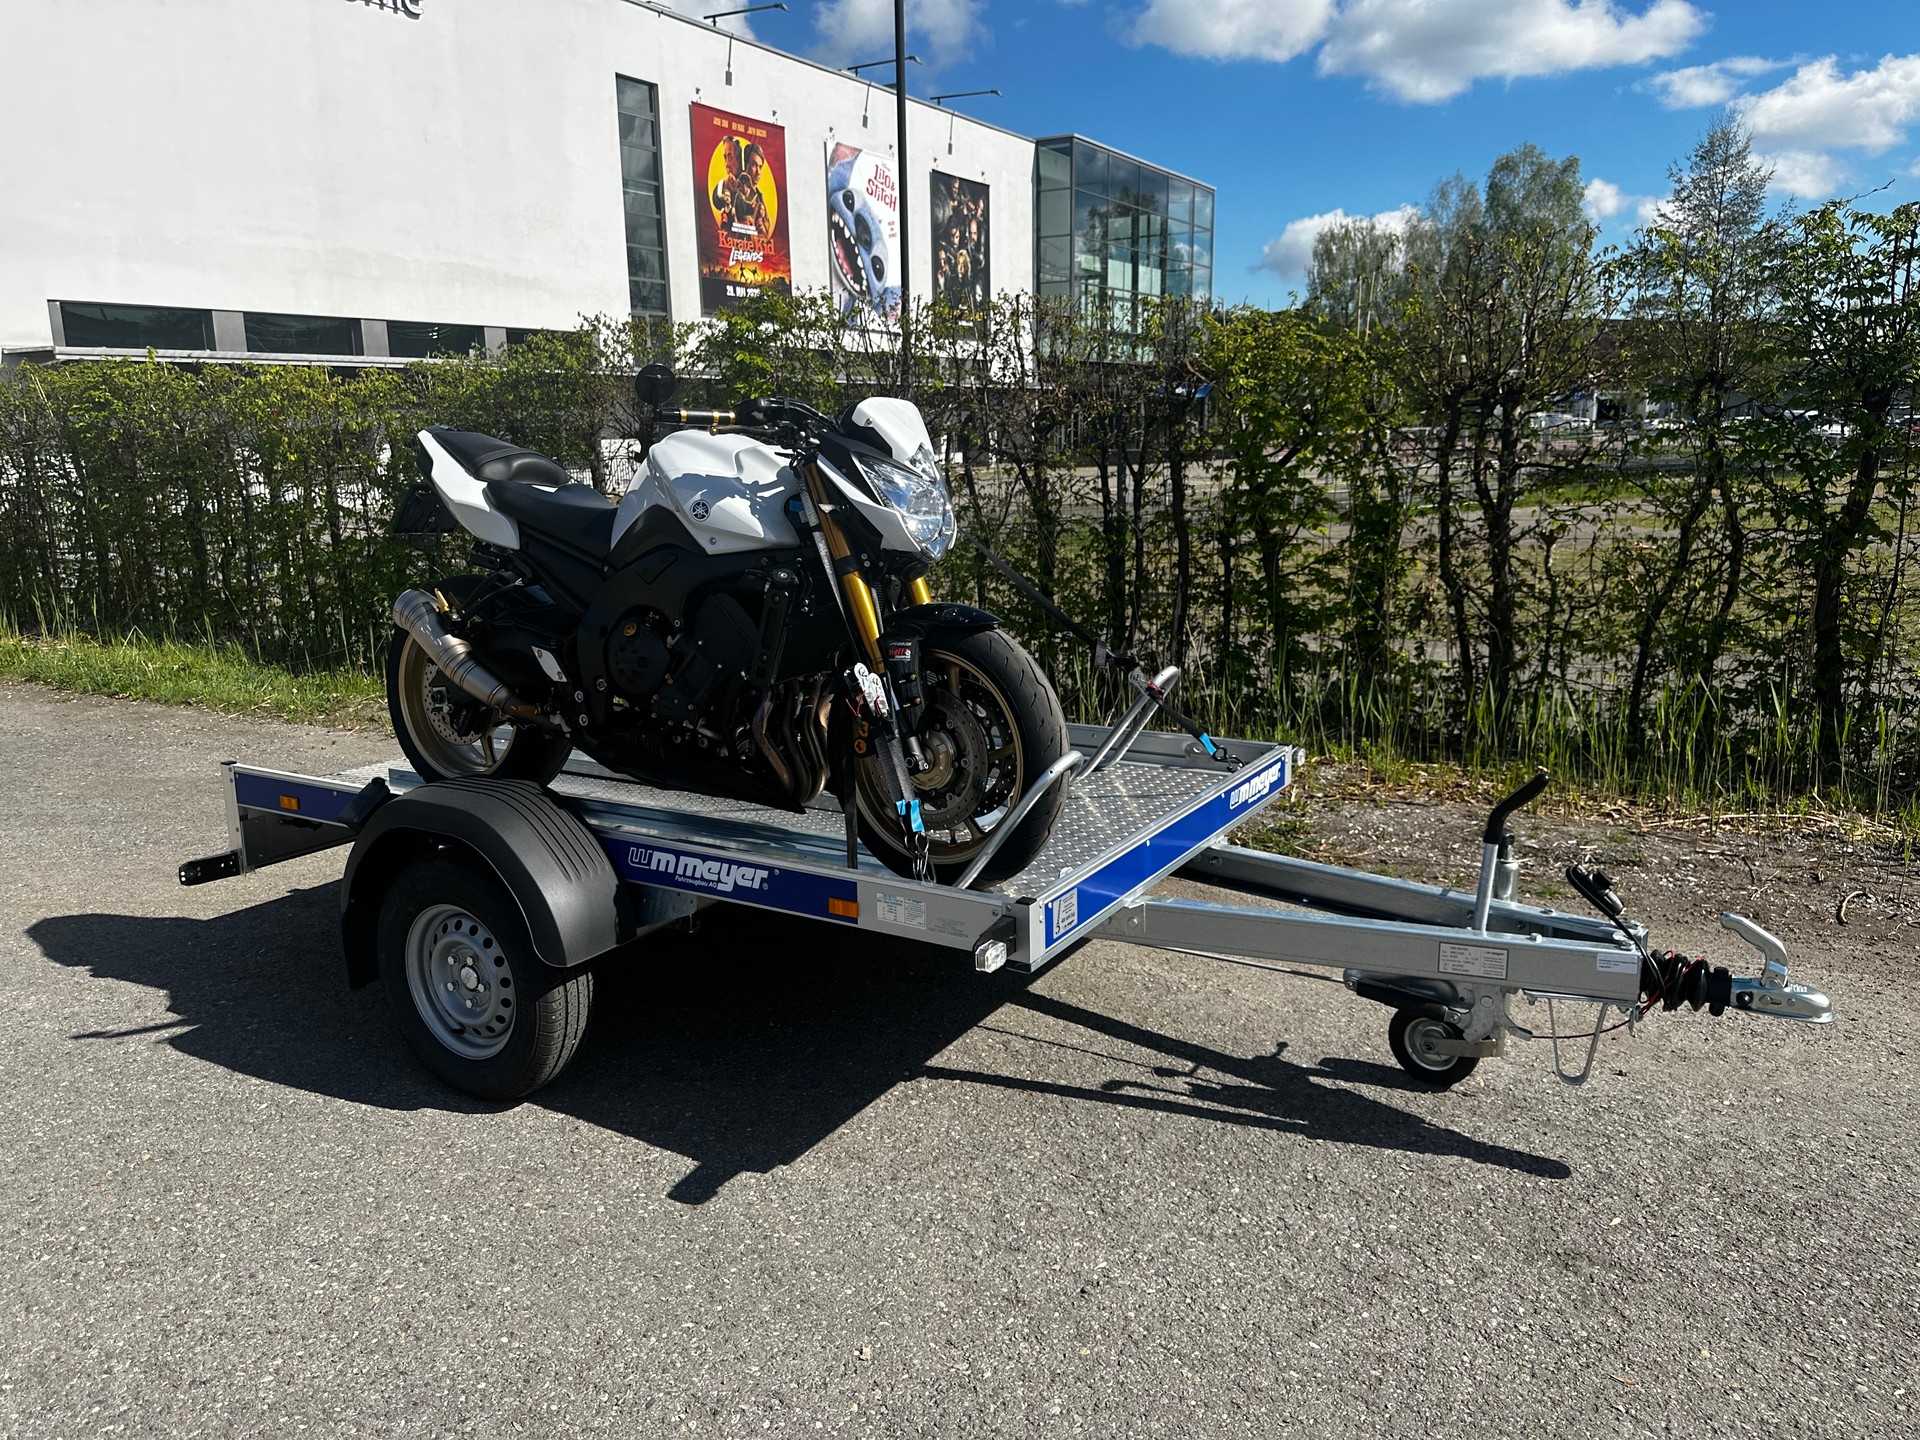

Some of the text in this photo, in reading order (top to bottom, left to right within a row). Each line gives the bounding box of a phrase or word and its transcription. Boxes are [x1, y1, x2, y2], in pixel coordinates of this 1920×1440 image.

[718, 230, 776, 255] Karate Kid
[675, 875, 718, 889] Fahrzeugbau AG
